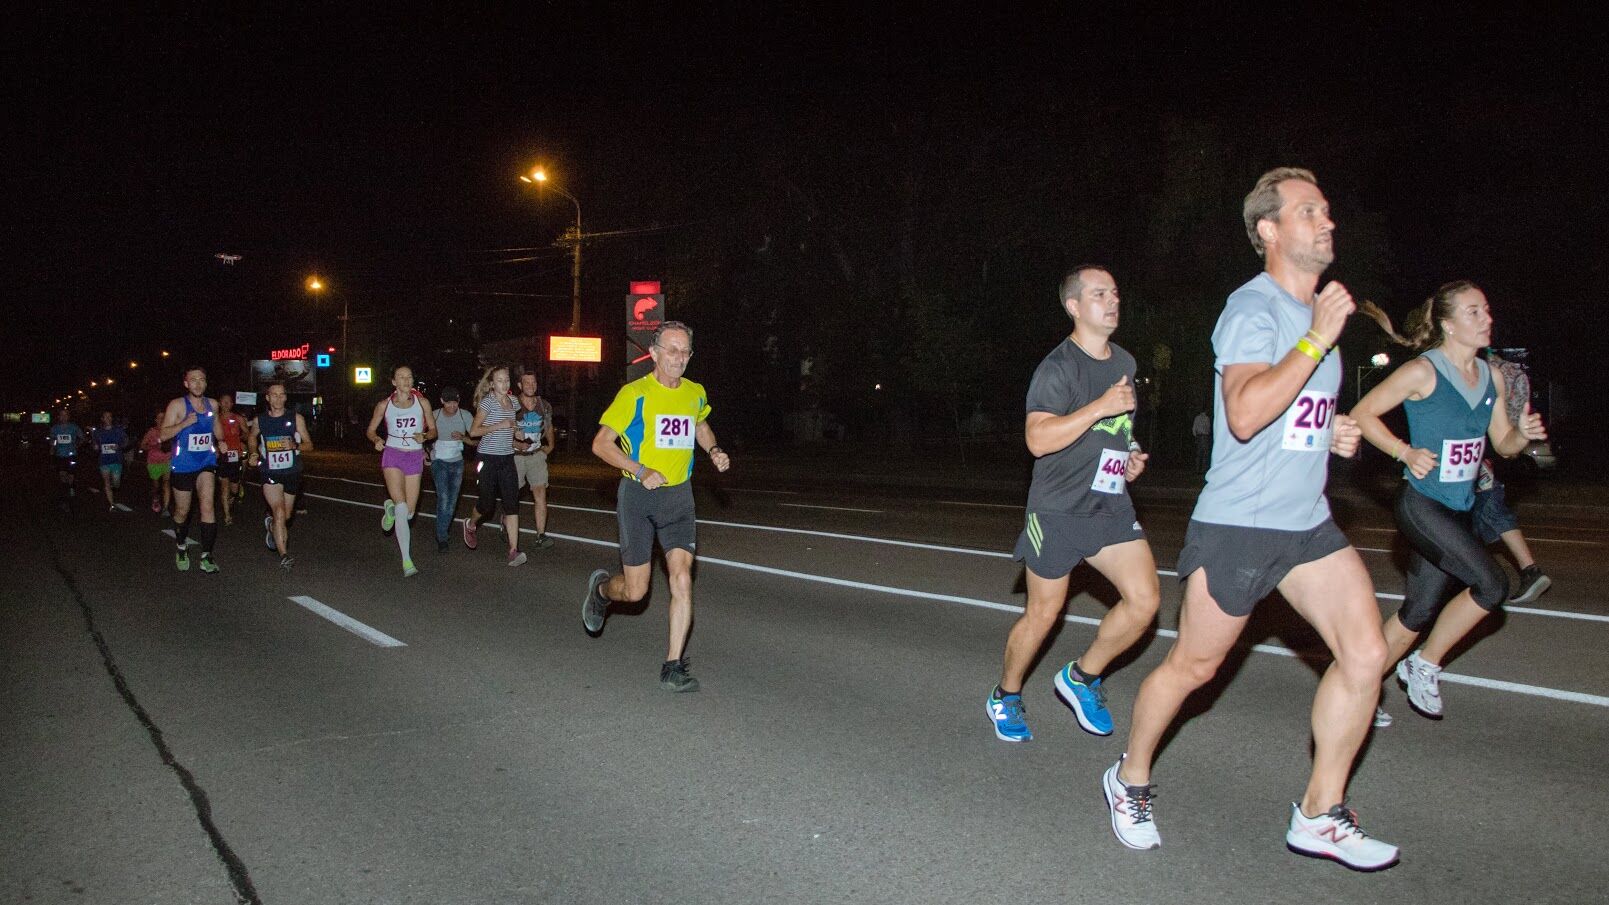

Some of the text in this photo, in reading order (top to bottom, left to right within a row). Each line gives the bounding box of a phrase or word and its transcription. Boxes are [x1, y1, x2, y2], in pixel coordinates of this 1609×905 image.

[396, 417, 417, 428] 572
[660, 417, 689, 437] 281
[192, 435, 210, 446] 160
[272, 453, 290, 463] 161
[1449, 440, 1482, 466] 553
